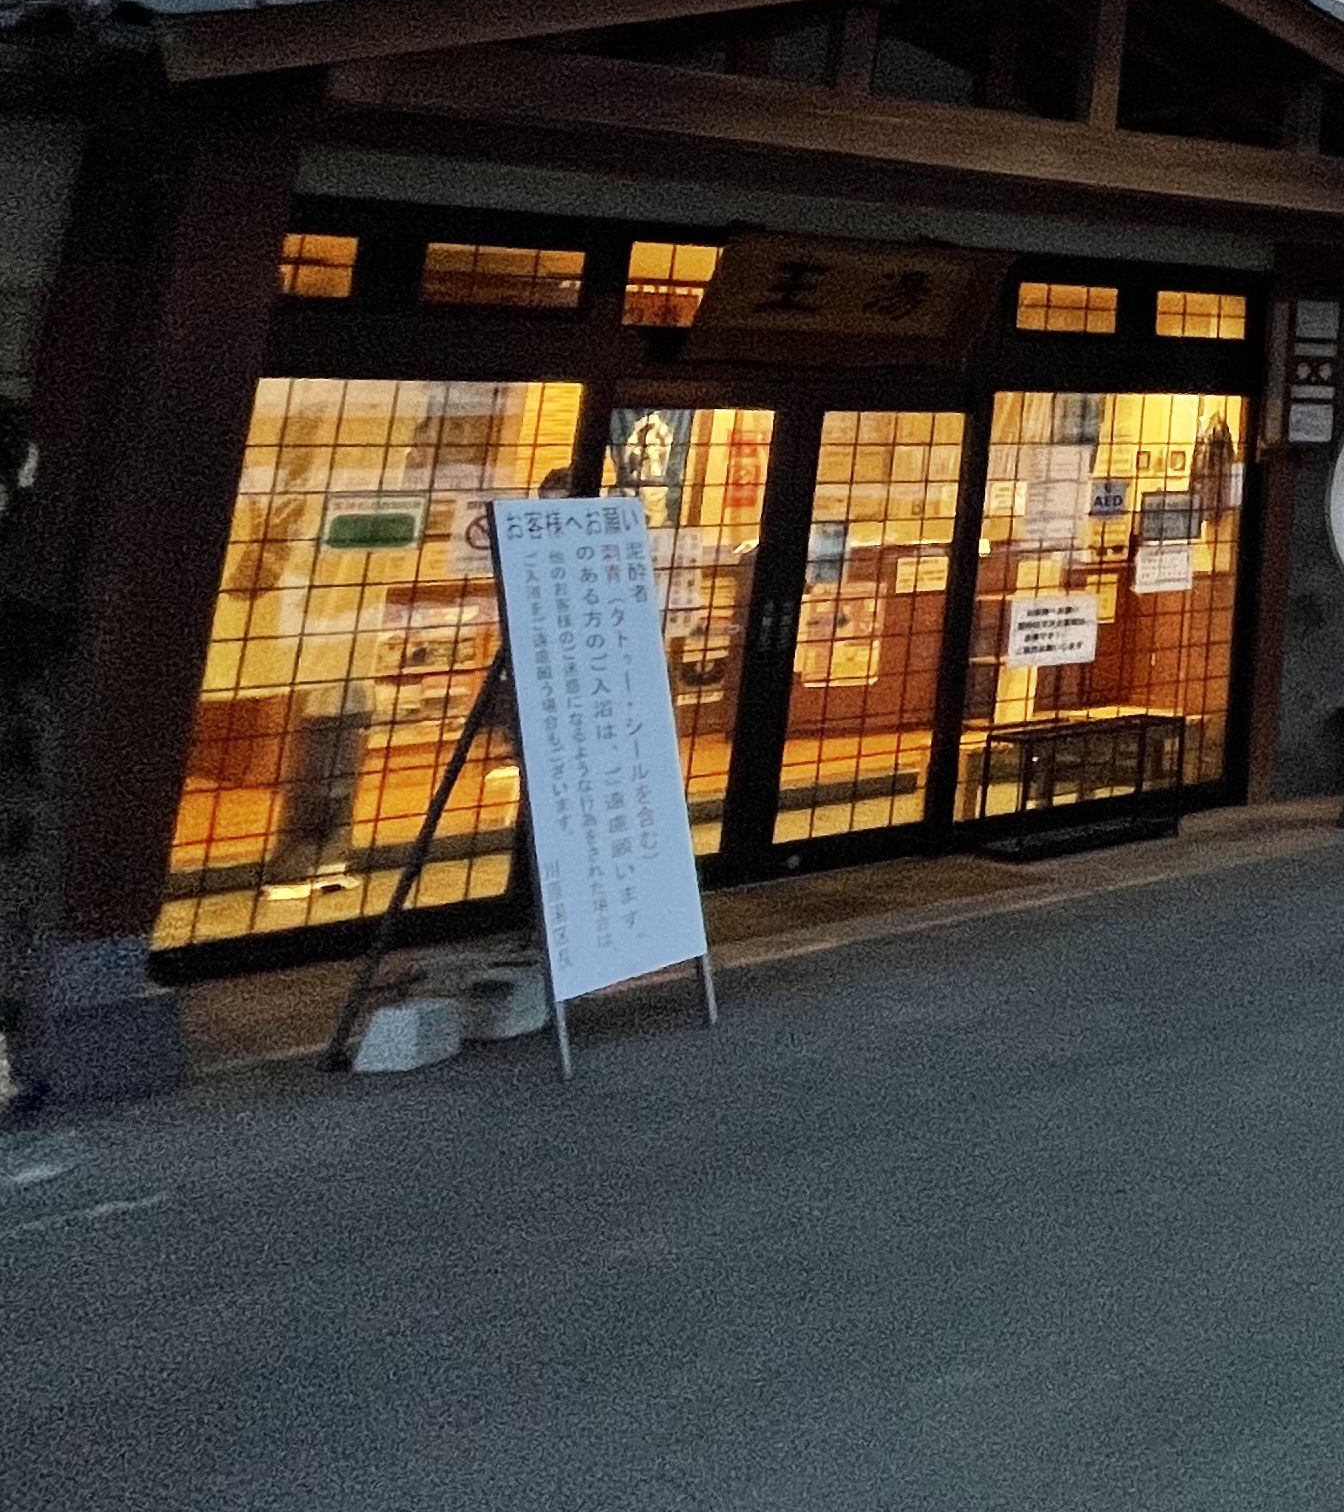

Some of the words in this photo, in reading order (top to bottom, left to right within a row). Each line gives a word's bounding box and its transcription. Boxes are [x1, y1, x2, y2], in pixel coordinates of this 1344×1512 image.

[1094, 494, 1124, 508] AED
[505, 506, 639, 541] お客様へお願い
[625, 540, 649, 604] 泥酔者
